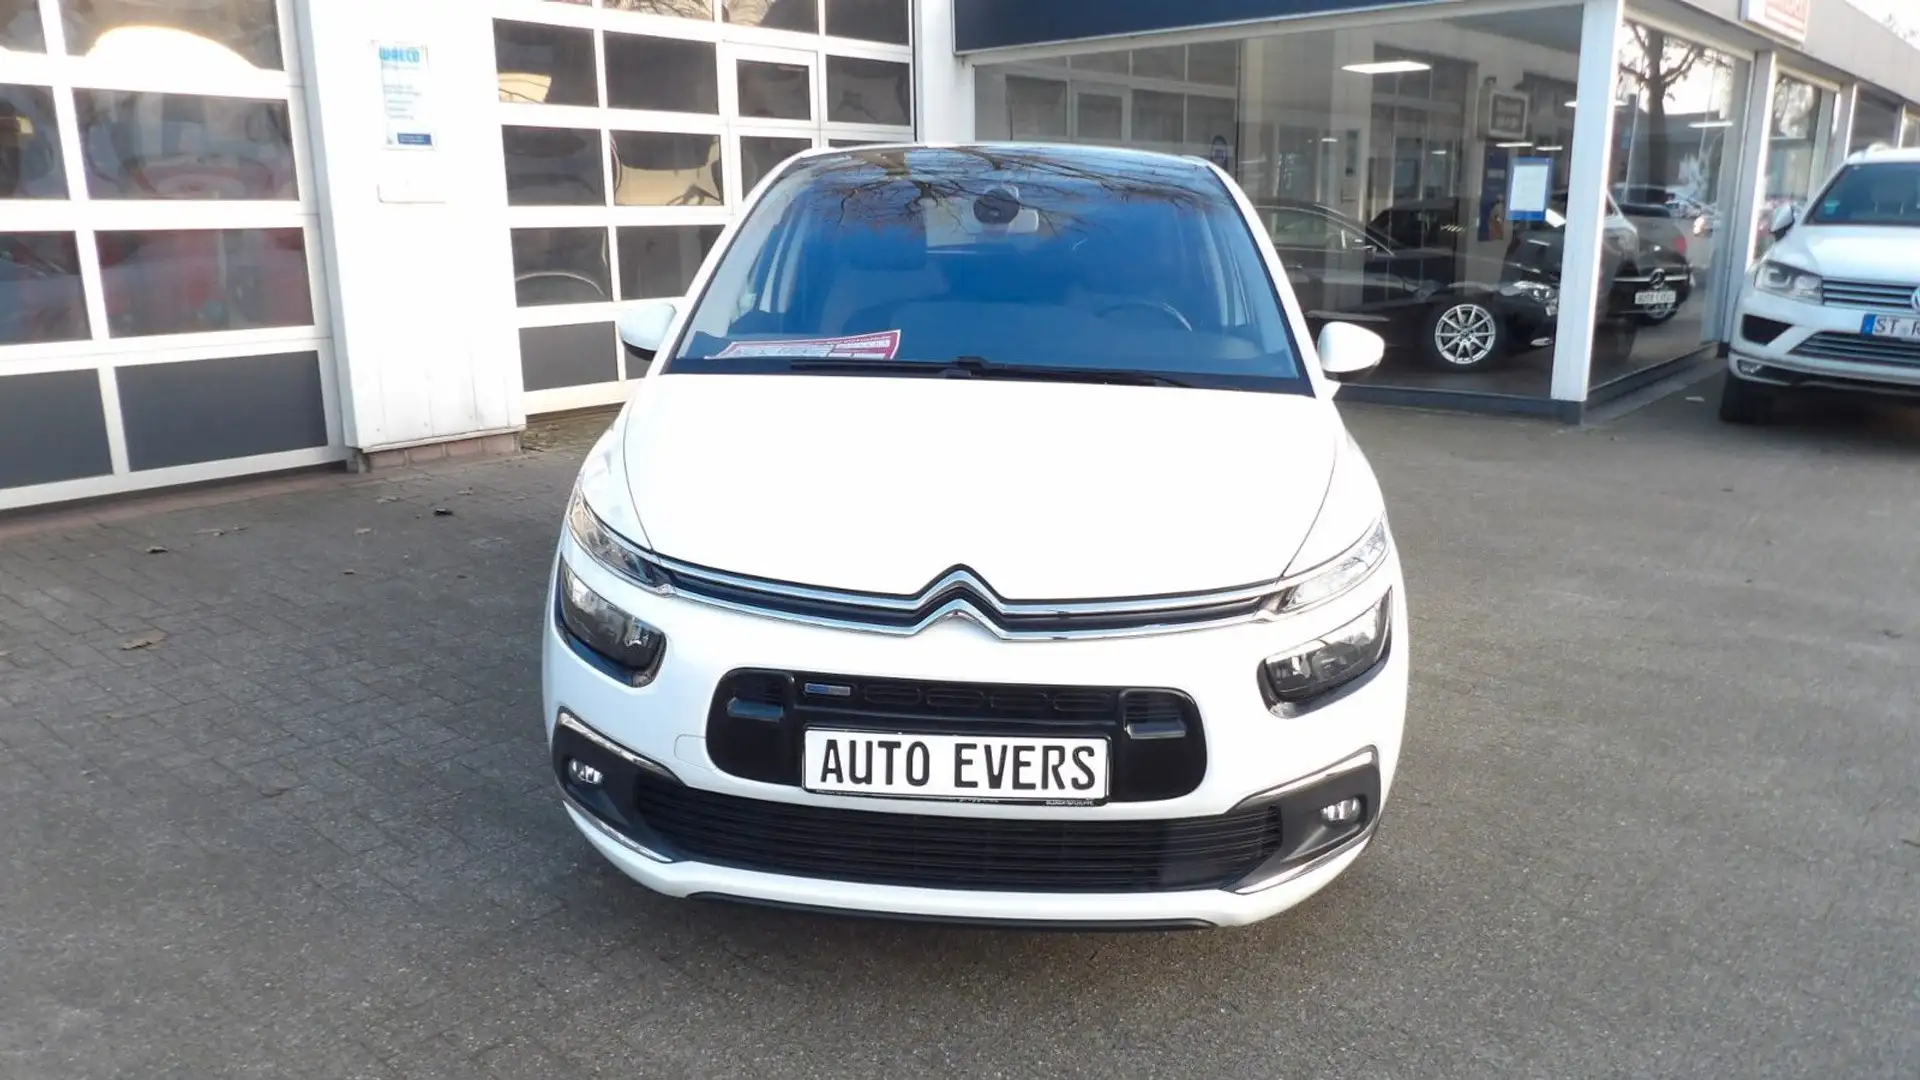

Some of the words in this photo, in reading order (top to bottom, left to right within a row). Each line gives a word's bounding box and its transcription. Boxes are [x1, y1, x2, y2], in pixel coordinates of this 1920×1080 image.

[1875, 317, 1900, 334] ST
[820, 739, 930, 787] AUTO
[954, 743, 1095, 791] EVERS
